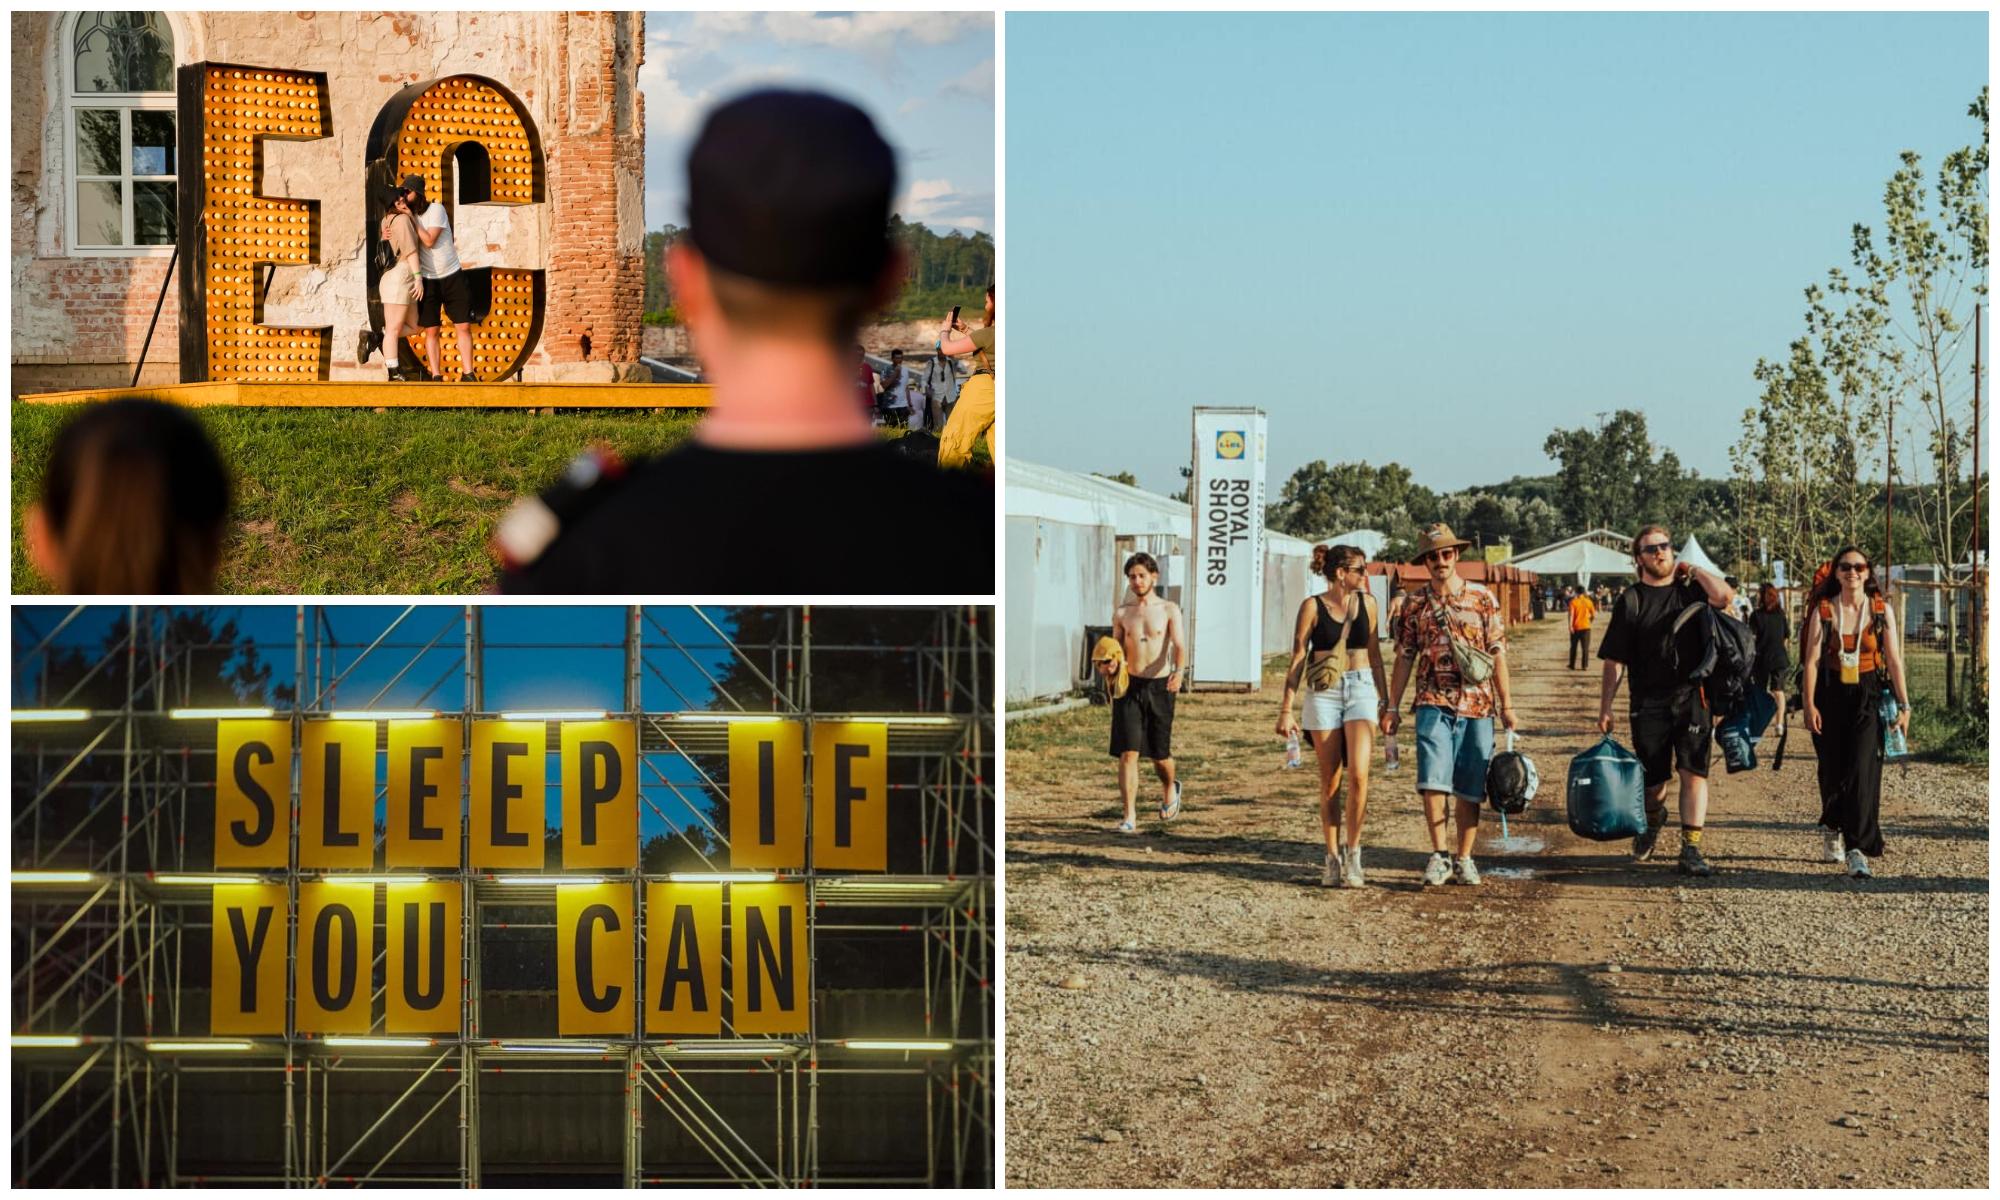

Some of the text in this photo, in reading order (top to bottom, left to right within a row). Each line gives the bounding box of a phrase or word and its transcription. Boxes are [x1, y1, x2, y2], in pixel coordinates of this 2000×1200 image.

[1207, 479, 1229, 586] SHOWERS
[1230, 479, 1250, 546] ROYAL
[230, 741, 871, 848] SLEEP IF
[226, 902, 795, 1013] YOU CAN
